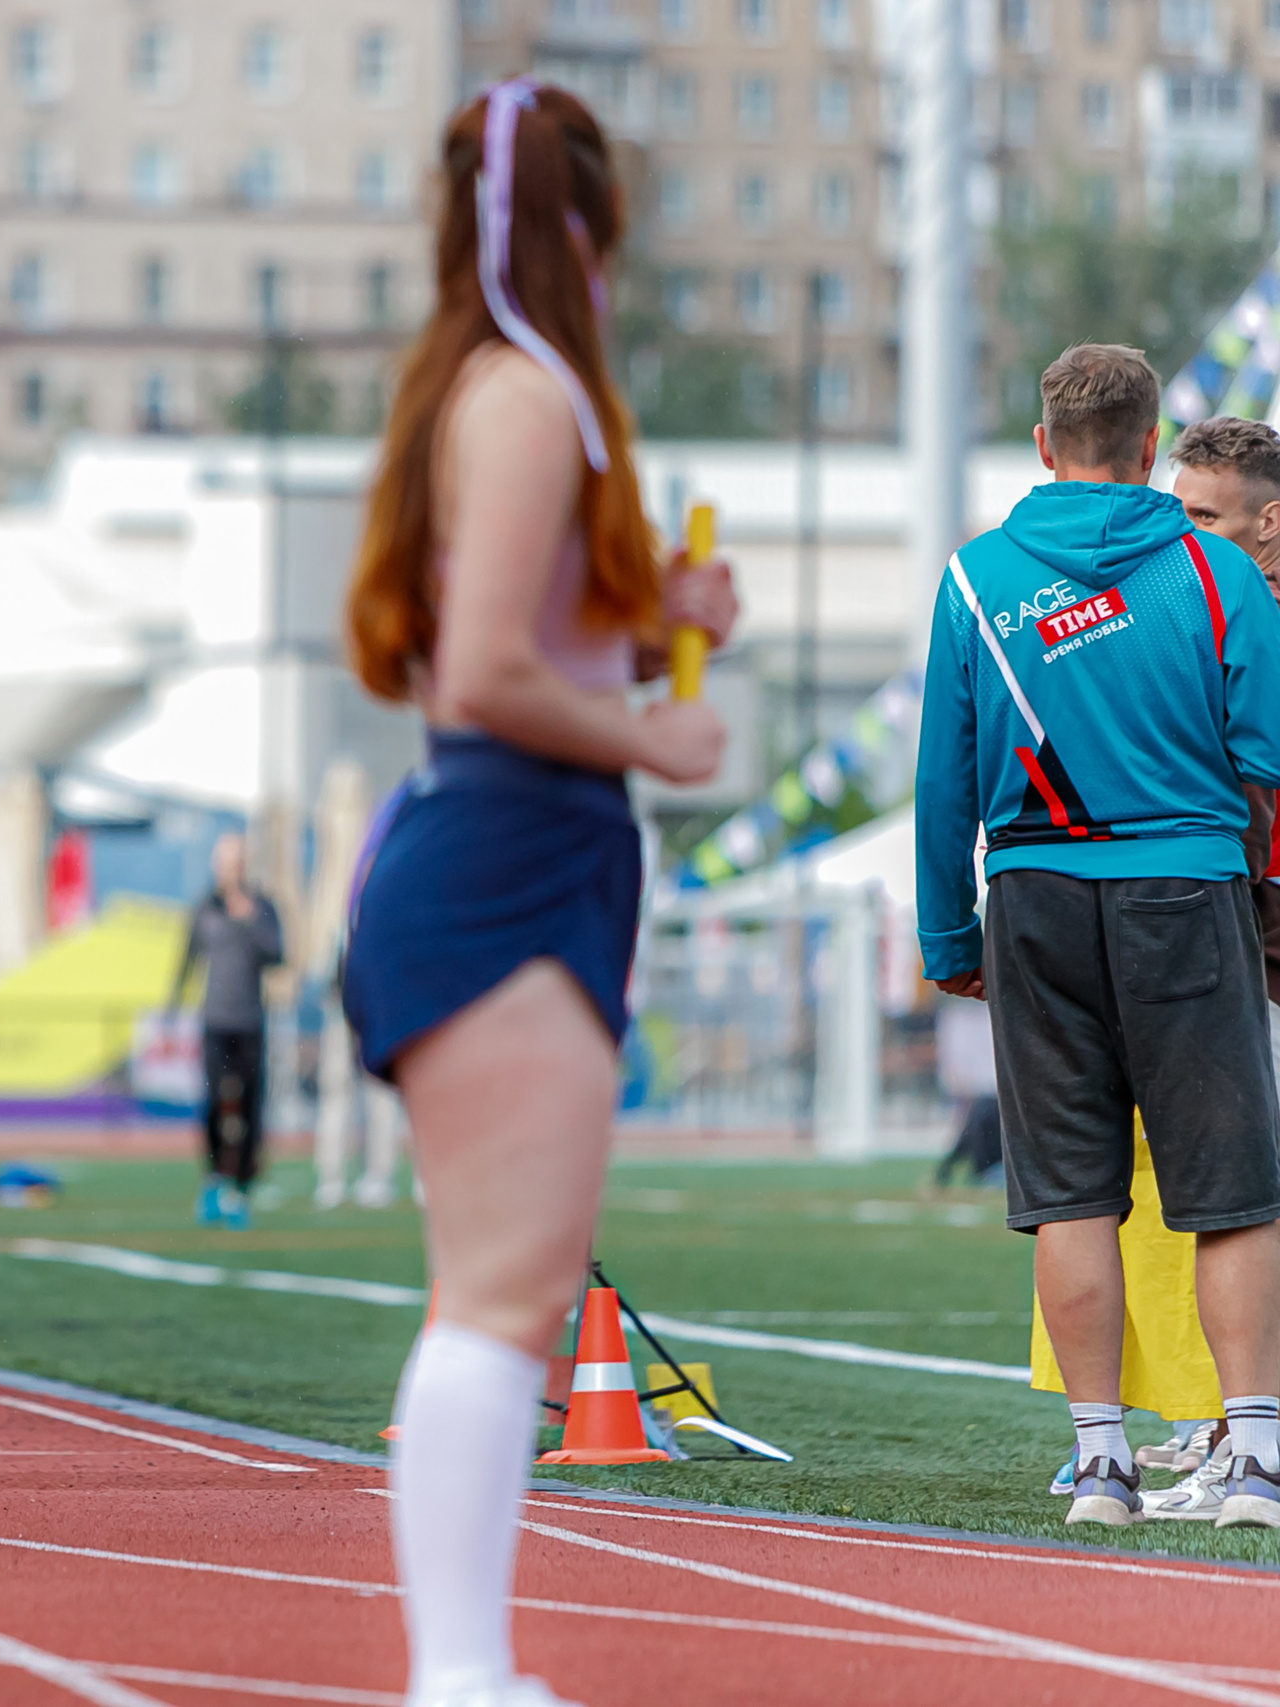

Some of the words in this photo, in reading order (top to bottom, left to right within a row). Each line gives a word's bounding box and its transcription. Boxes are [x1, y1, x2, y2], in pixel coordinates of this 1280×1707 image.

[993, 579, 1077, 639] RACE
[1046, 597, 1114, 638] TIME
[1042, 637, 1083, 664] ВРЕМЯ
